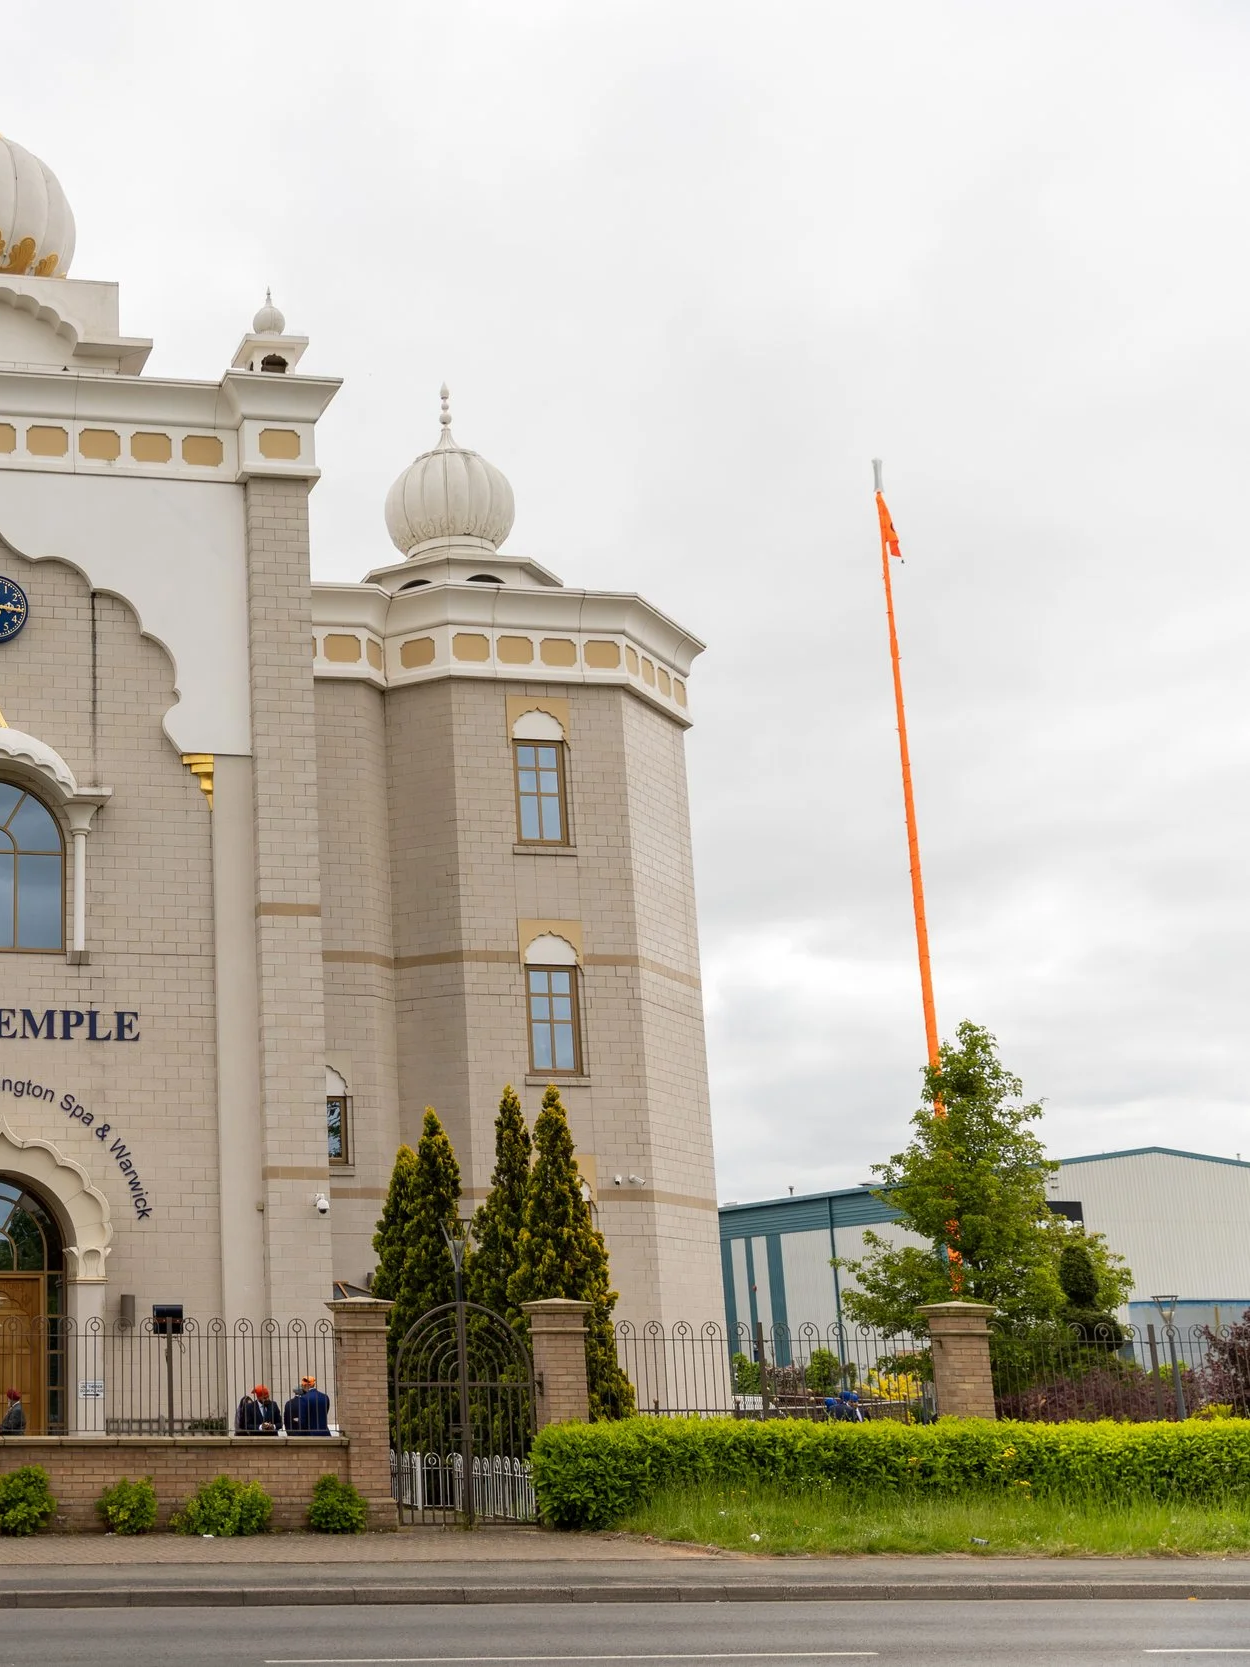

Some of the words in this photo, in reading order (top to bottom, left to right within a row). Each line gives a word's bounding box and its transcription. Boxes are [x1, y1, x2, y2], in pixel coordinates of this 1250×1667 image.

[4, 586, 8, 594] 1
[12, 593, 17, 601] 2
[11, 615, 17, 623] 4
[3, 622, 9, 630] 5
[59, 1093, 96, 1127] Spa
[95, 1123, 111, 1141] &
[109, 1137, 153, 1221] Warwick
